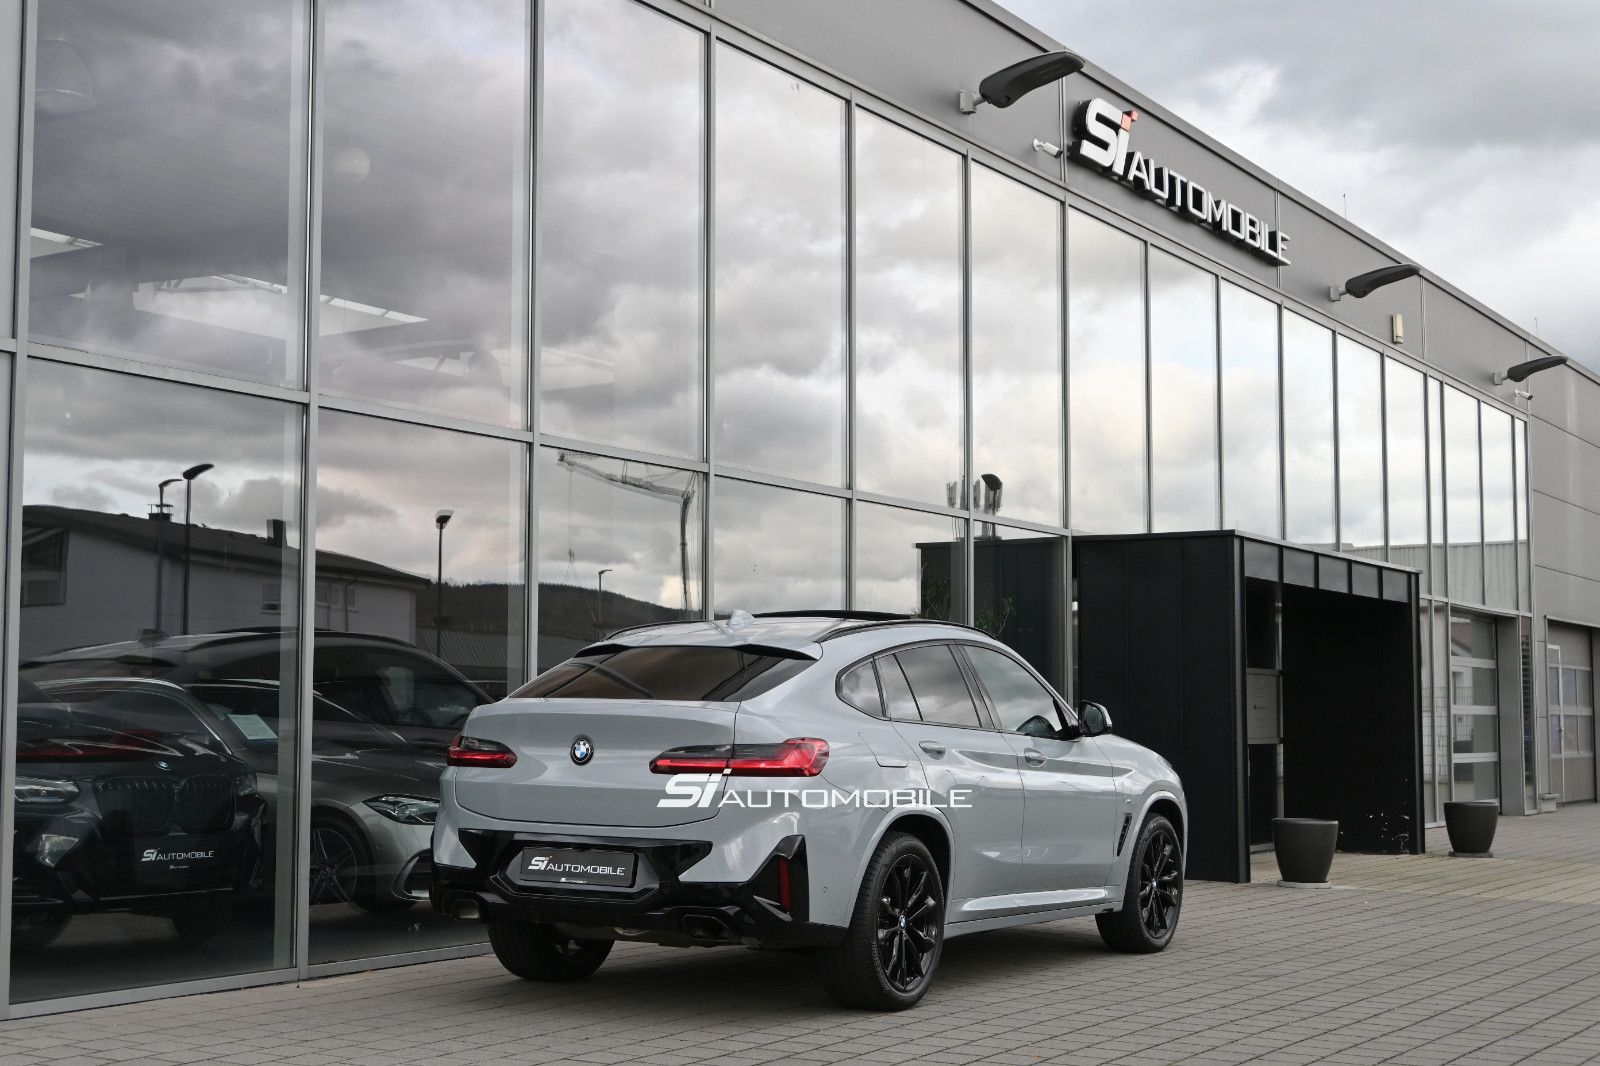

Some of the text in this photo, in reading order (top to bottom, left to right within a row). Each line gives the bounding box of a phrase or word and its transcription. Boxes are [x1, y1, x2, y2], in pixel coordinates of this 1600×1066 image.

[1080, 98, 1291, 265] Si AUTOMOBILE
[156, 850, 214, 861] AUTOMOBILE
[546, 863, 625, 876] AUTOMOBILE
